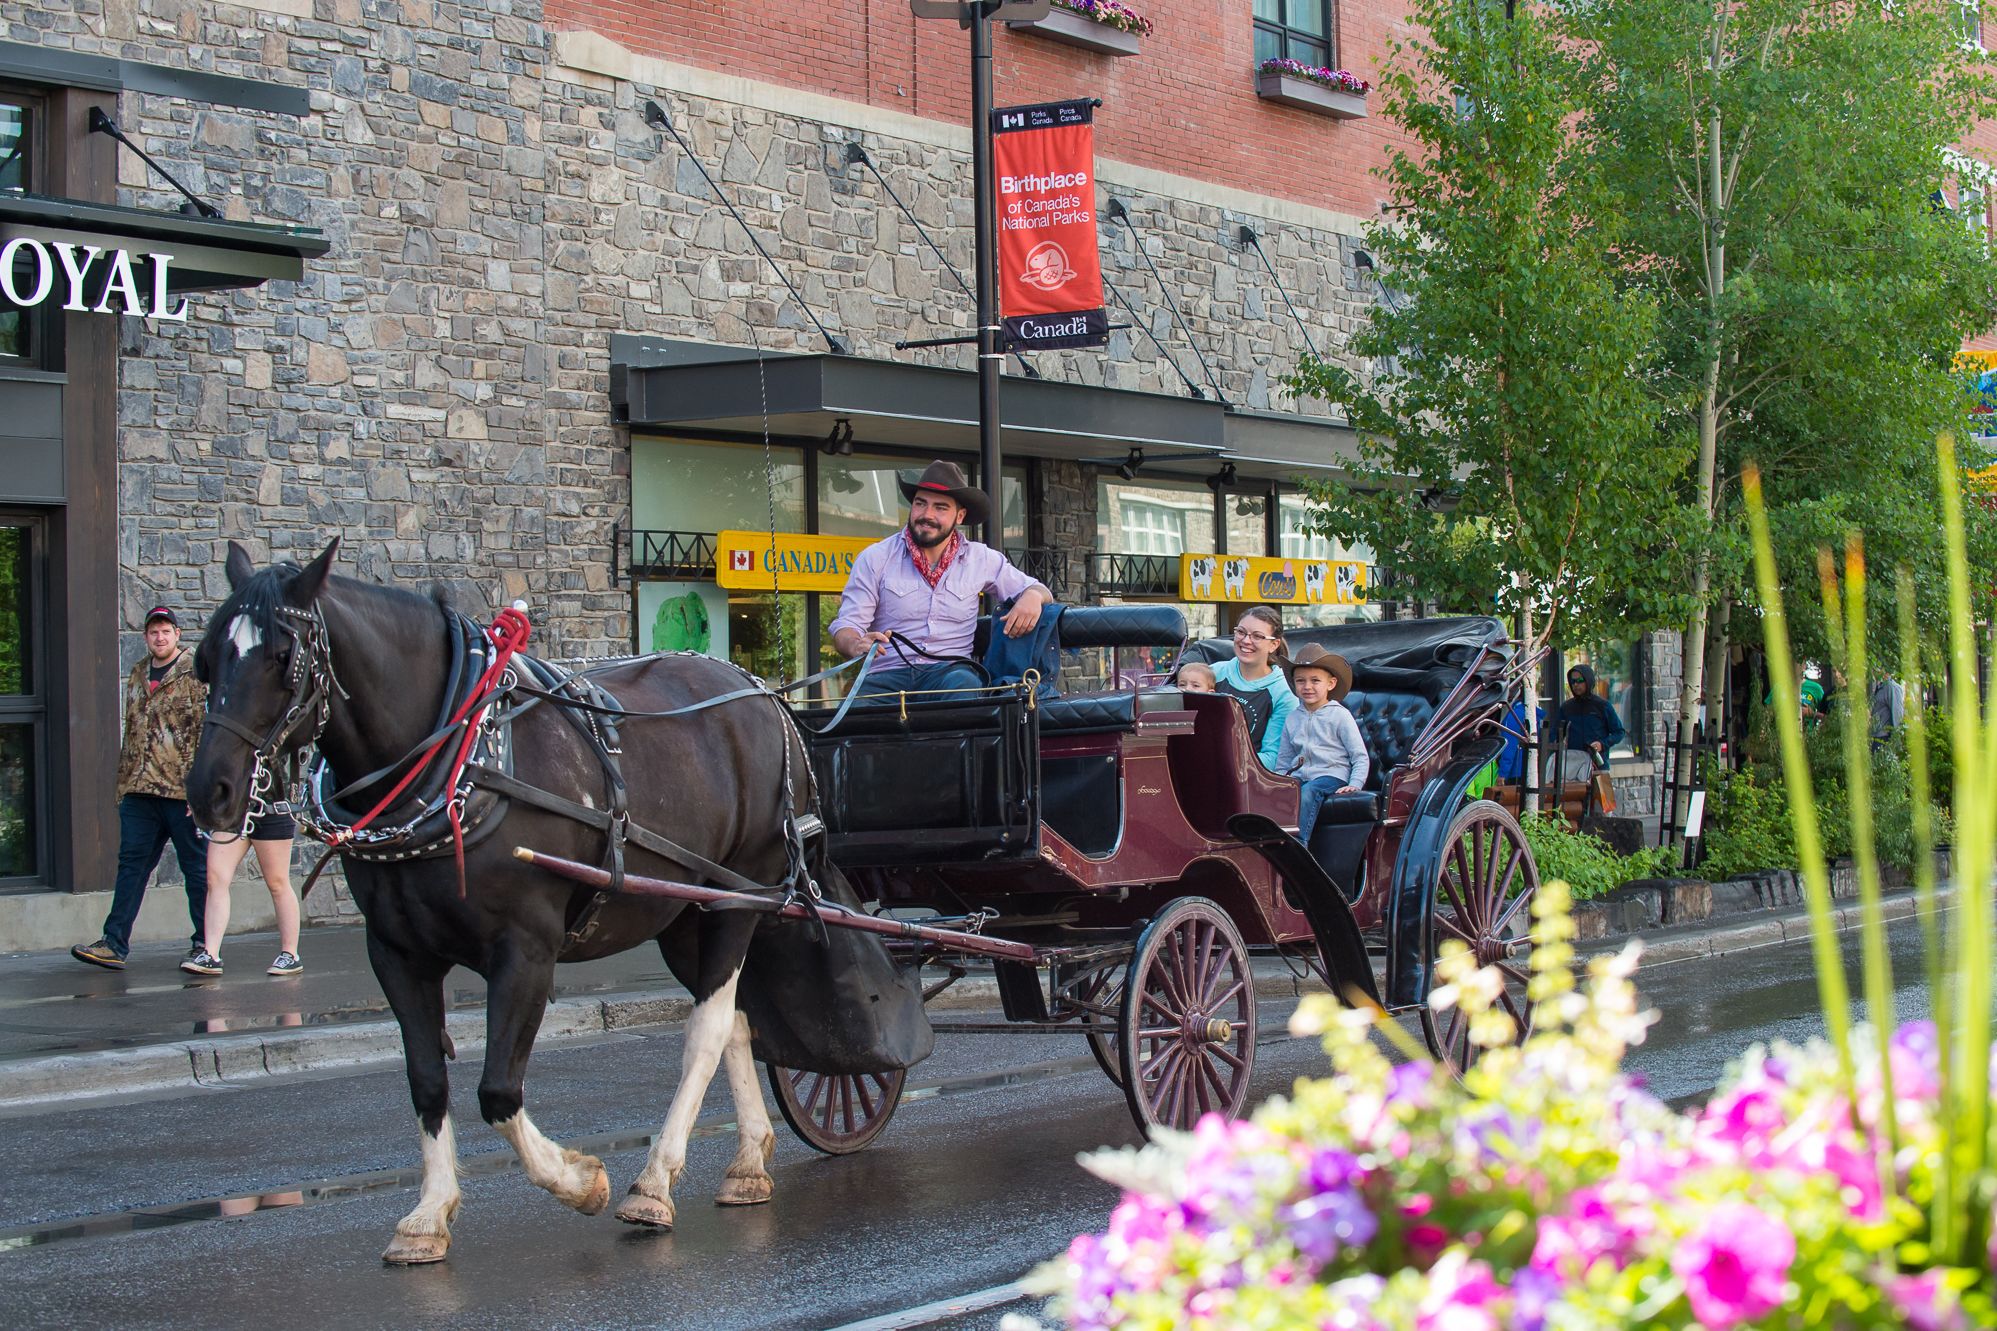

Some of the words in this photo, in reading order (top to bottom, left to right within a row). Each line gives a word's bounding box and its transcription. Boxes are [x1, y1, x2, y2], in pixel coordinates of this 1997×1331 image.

[1032, 118, 1053, 126] Canada
[1060, 114, 1082, 122] Canada
[1001, 171, 1087, 193] Birthplace
[1008, 200, 1022, 214] of
[1024, 193, 1080, 213] Canada's
[1002, 213, 1050, 231] National
[1053, 210, 1090, 226] Parks
[0, 237, 188, 321] OYAL
[1020, 316, 1088, 339] Canada
[763, 549, 853, 575] CANADA'S
